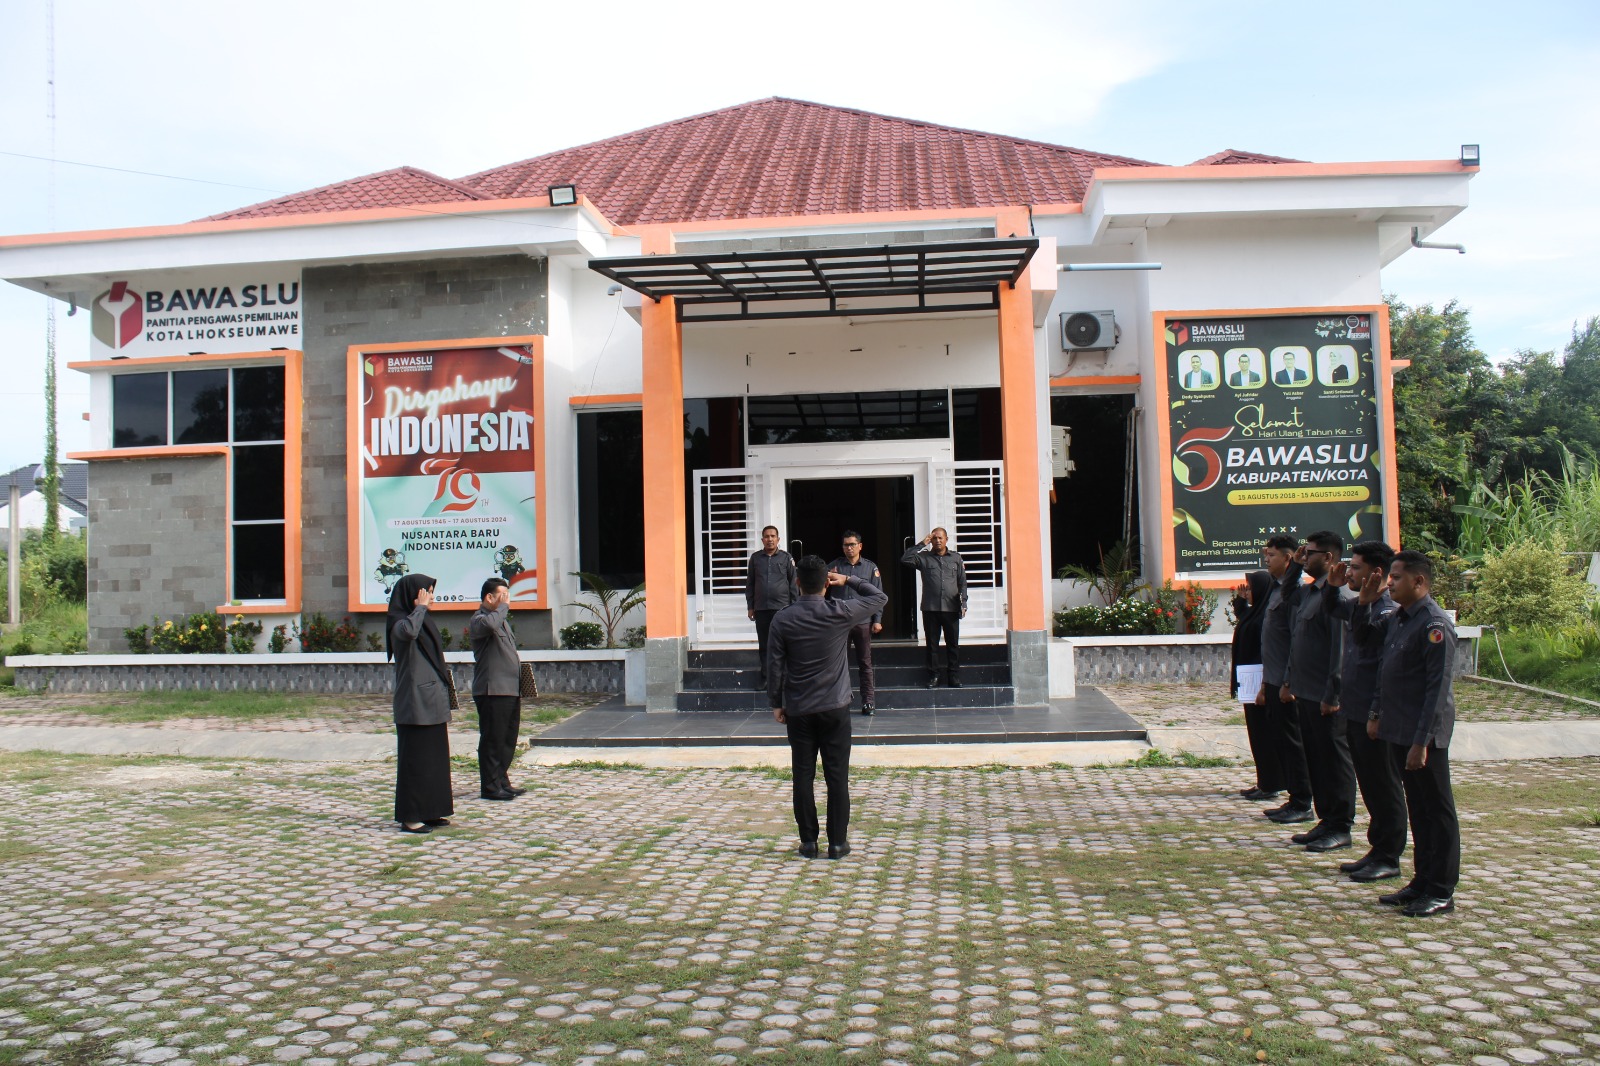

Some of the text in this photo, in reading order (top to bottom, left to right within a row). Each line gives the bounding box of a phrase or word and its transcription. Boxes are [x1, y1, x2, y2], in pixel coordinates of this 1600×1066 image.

[146, 282, 298, 312] BAWASLU
[146, 311, 298, 327] PANITIA PENGAWAS PEMILIHAN
[147, 324, 298, 341] KOTA LHOKSEUMAWE
[1192, 324, 1244, 335] BAWASLU
[388, 356, 432, 366] BAWASLU
[385, 375, 517, 421] Dirgahayu
[1234, 403, 1304, 436] Selamat
[371, 411, 530, 457] INDONESIA
[1279, 429, 1303, 438] Ulang
[1306, 428, 1333, 436] Tahun
[1356, 427, 1362, 435] 6
[1226, 444, 1368, 468] BAWASLU
[1227, 468, 1368, 485] KABUPATEN/KOTA
[401, 528, 500, 540] NUSANTARA BARU
[404, 540, 497, 551] INDONESIA MAJU
[1212, 539, 1251, 547] Bersama
[1181, 547, 1259, 557] Bersama Bawaslu
